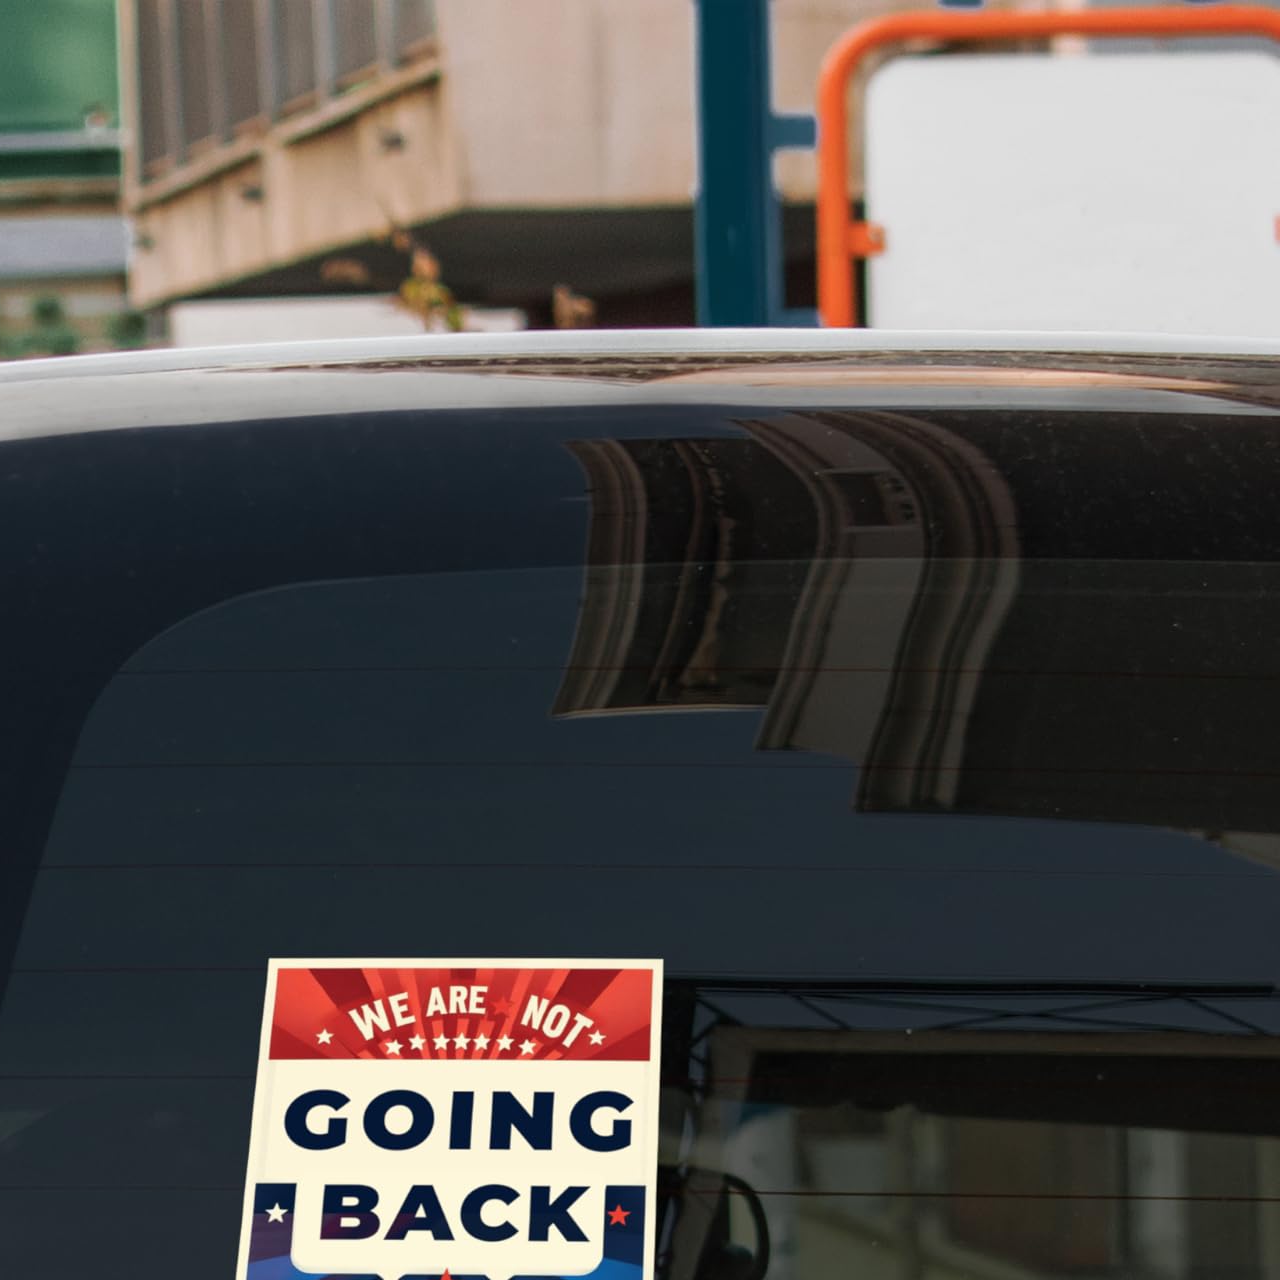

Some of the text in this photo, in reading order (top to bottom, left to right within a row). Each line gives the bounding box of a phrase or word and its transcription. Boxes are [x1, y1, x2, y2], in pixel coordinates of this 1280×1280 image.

[348, 985, 596, 1048] WE ARE NOT
[284, 1089, 635, 1152] GOING
[319, 1184, 591, 1242] BACK
